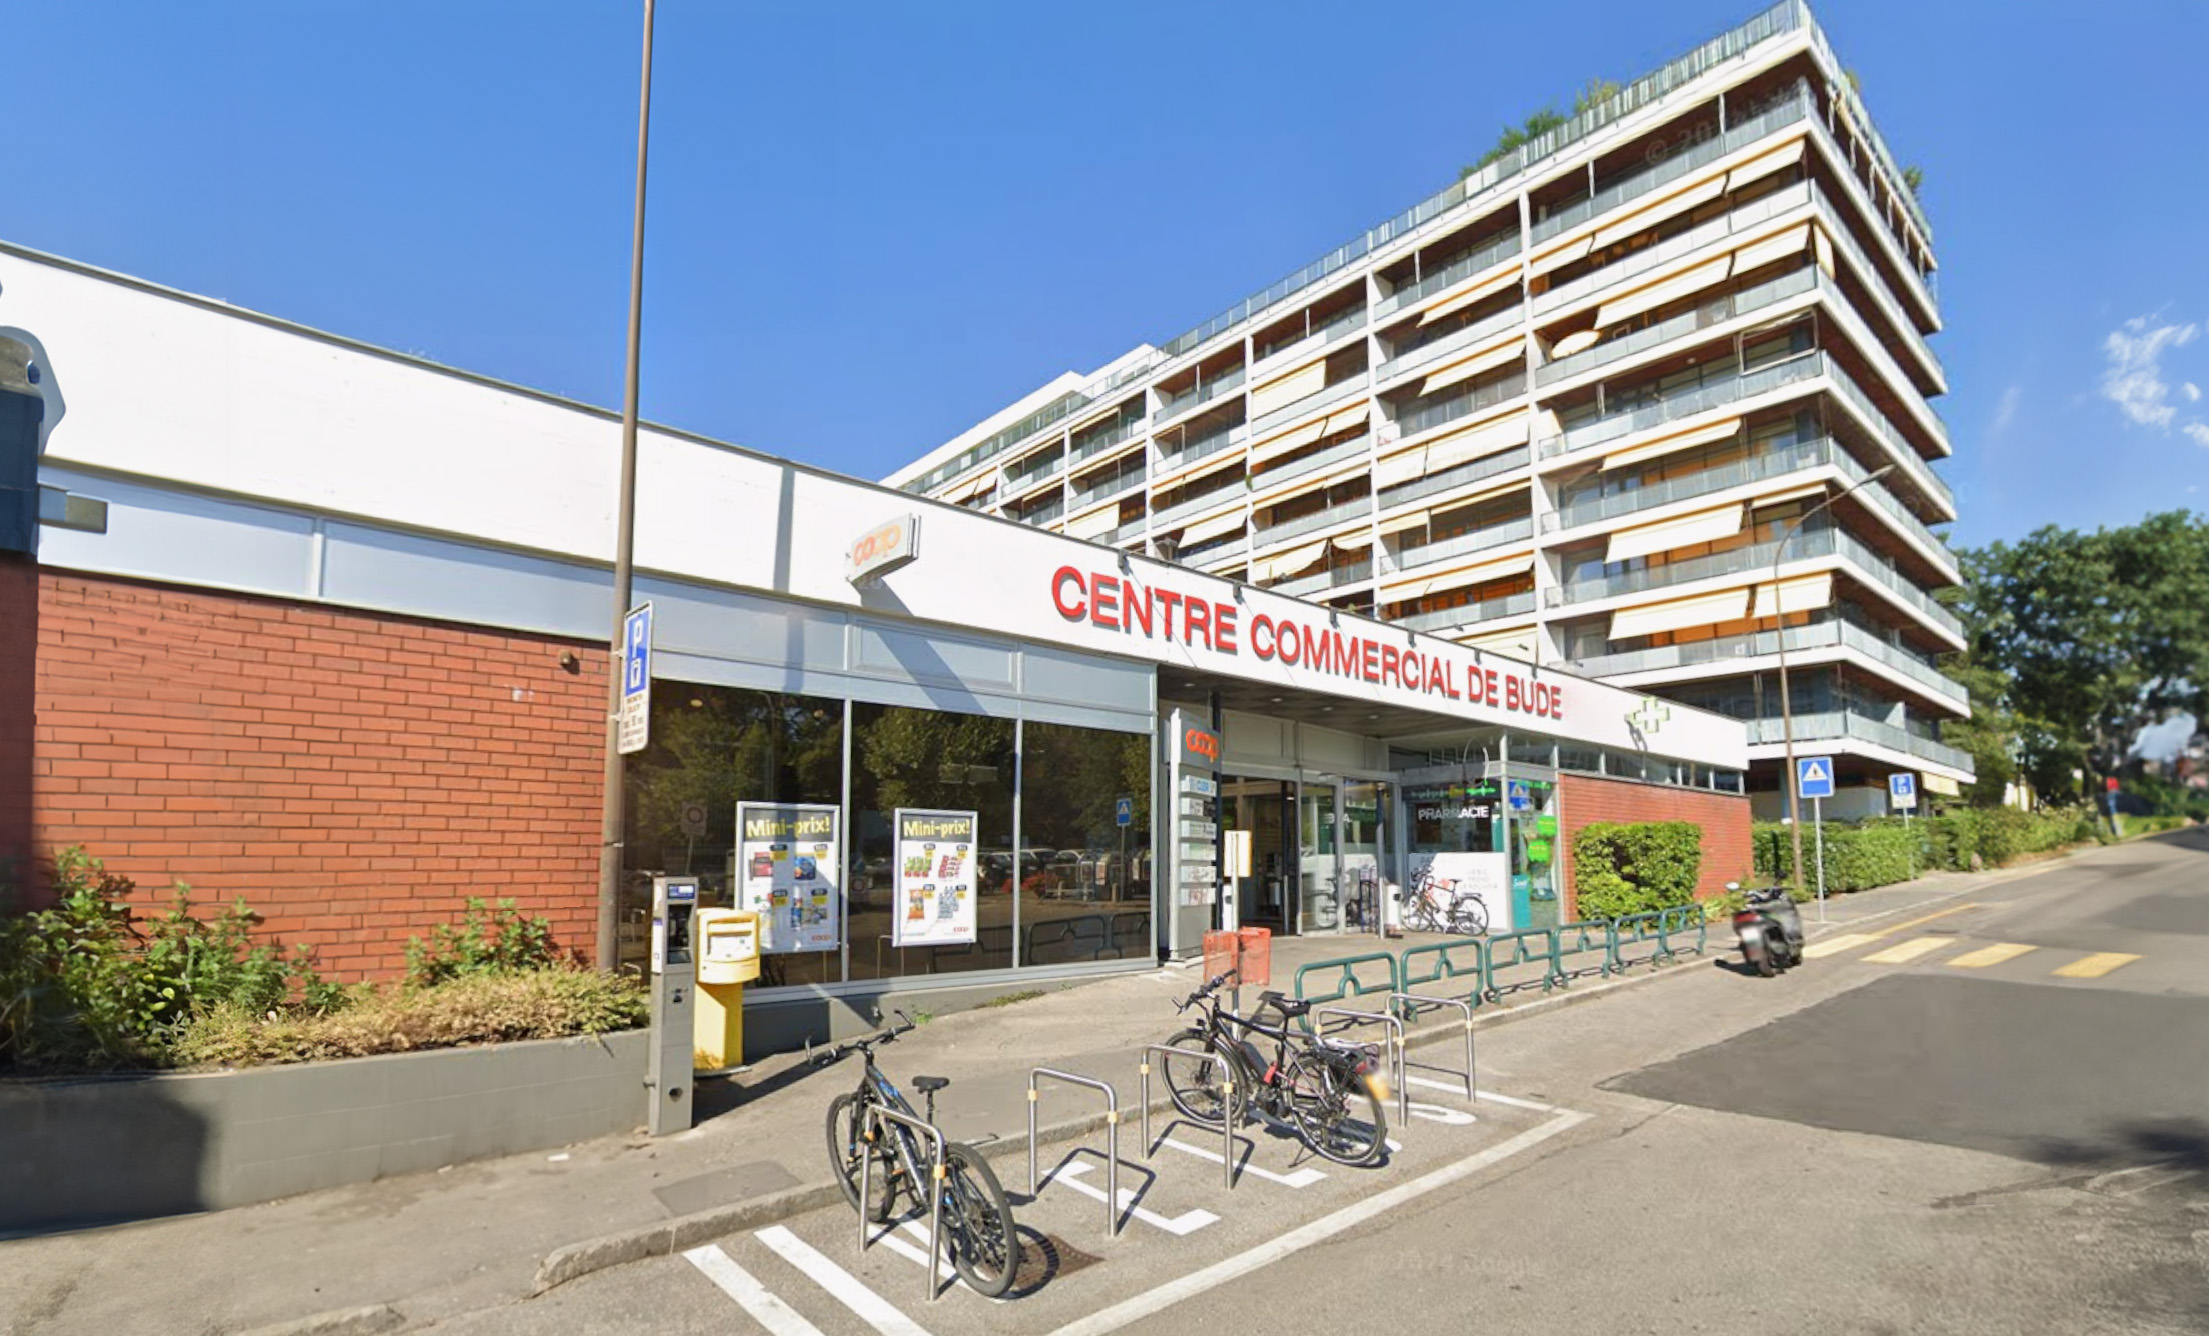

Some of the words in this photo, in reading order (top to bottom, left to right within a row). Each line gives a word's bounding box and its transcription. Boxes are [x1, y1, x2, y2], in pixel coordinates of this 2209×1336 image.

[1052, 566, 1237, 653] CENTRE
[1251, 614, 1461, 700] COMMERCIAL
[1468, 666, 1499, 705] DE
[1505, 675, 1563, 720] BUDE
[745, 816, 831, 839] Mini-prix!
[903, 819, 971, 839] Mini-prix!
